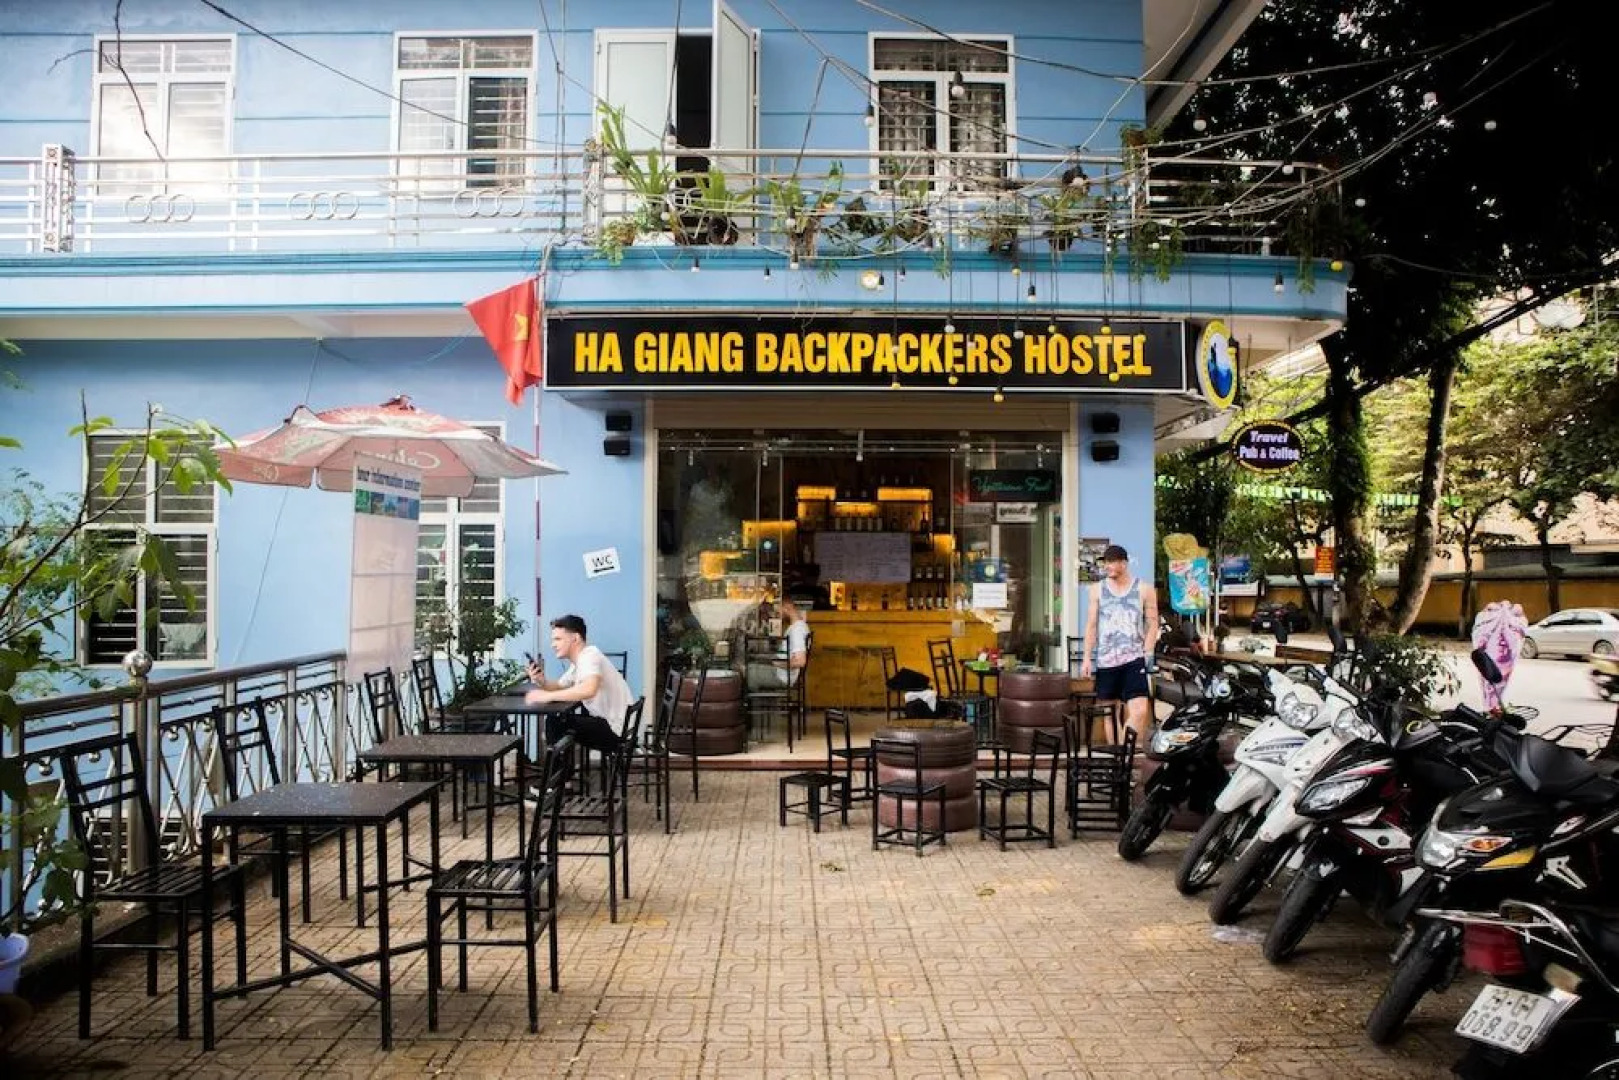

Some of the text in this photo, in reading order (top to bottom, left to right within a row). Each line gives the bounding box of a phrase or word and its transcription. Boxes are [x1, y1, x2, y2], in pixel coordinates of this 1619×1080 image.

[575, 332, 1152, 376] HA GIANG BACKPACKERS HOSTEL
[1250, 430, 1290, 443] Travel
[1239, 445, 1259, 459] Pub
[1269, 446, 1300, 460] Coffee
[592, 555, 613, 567] WC
